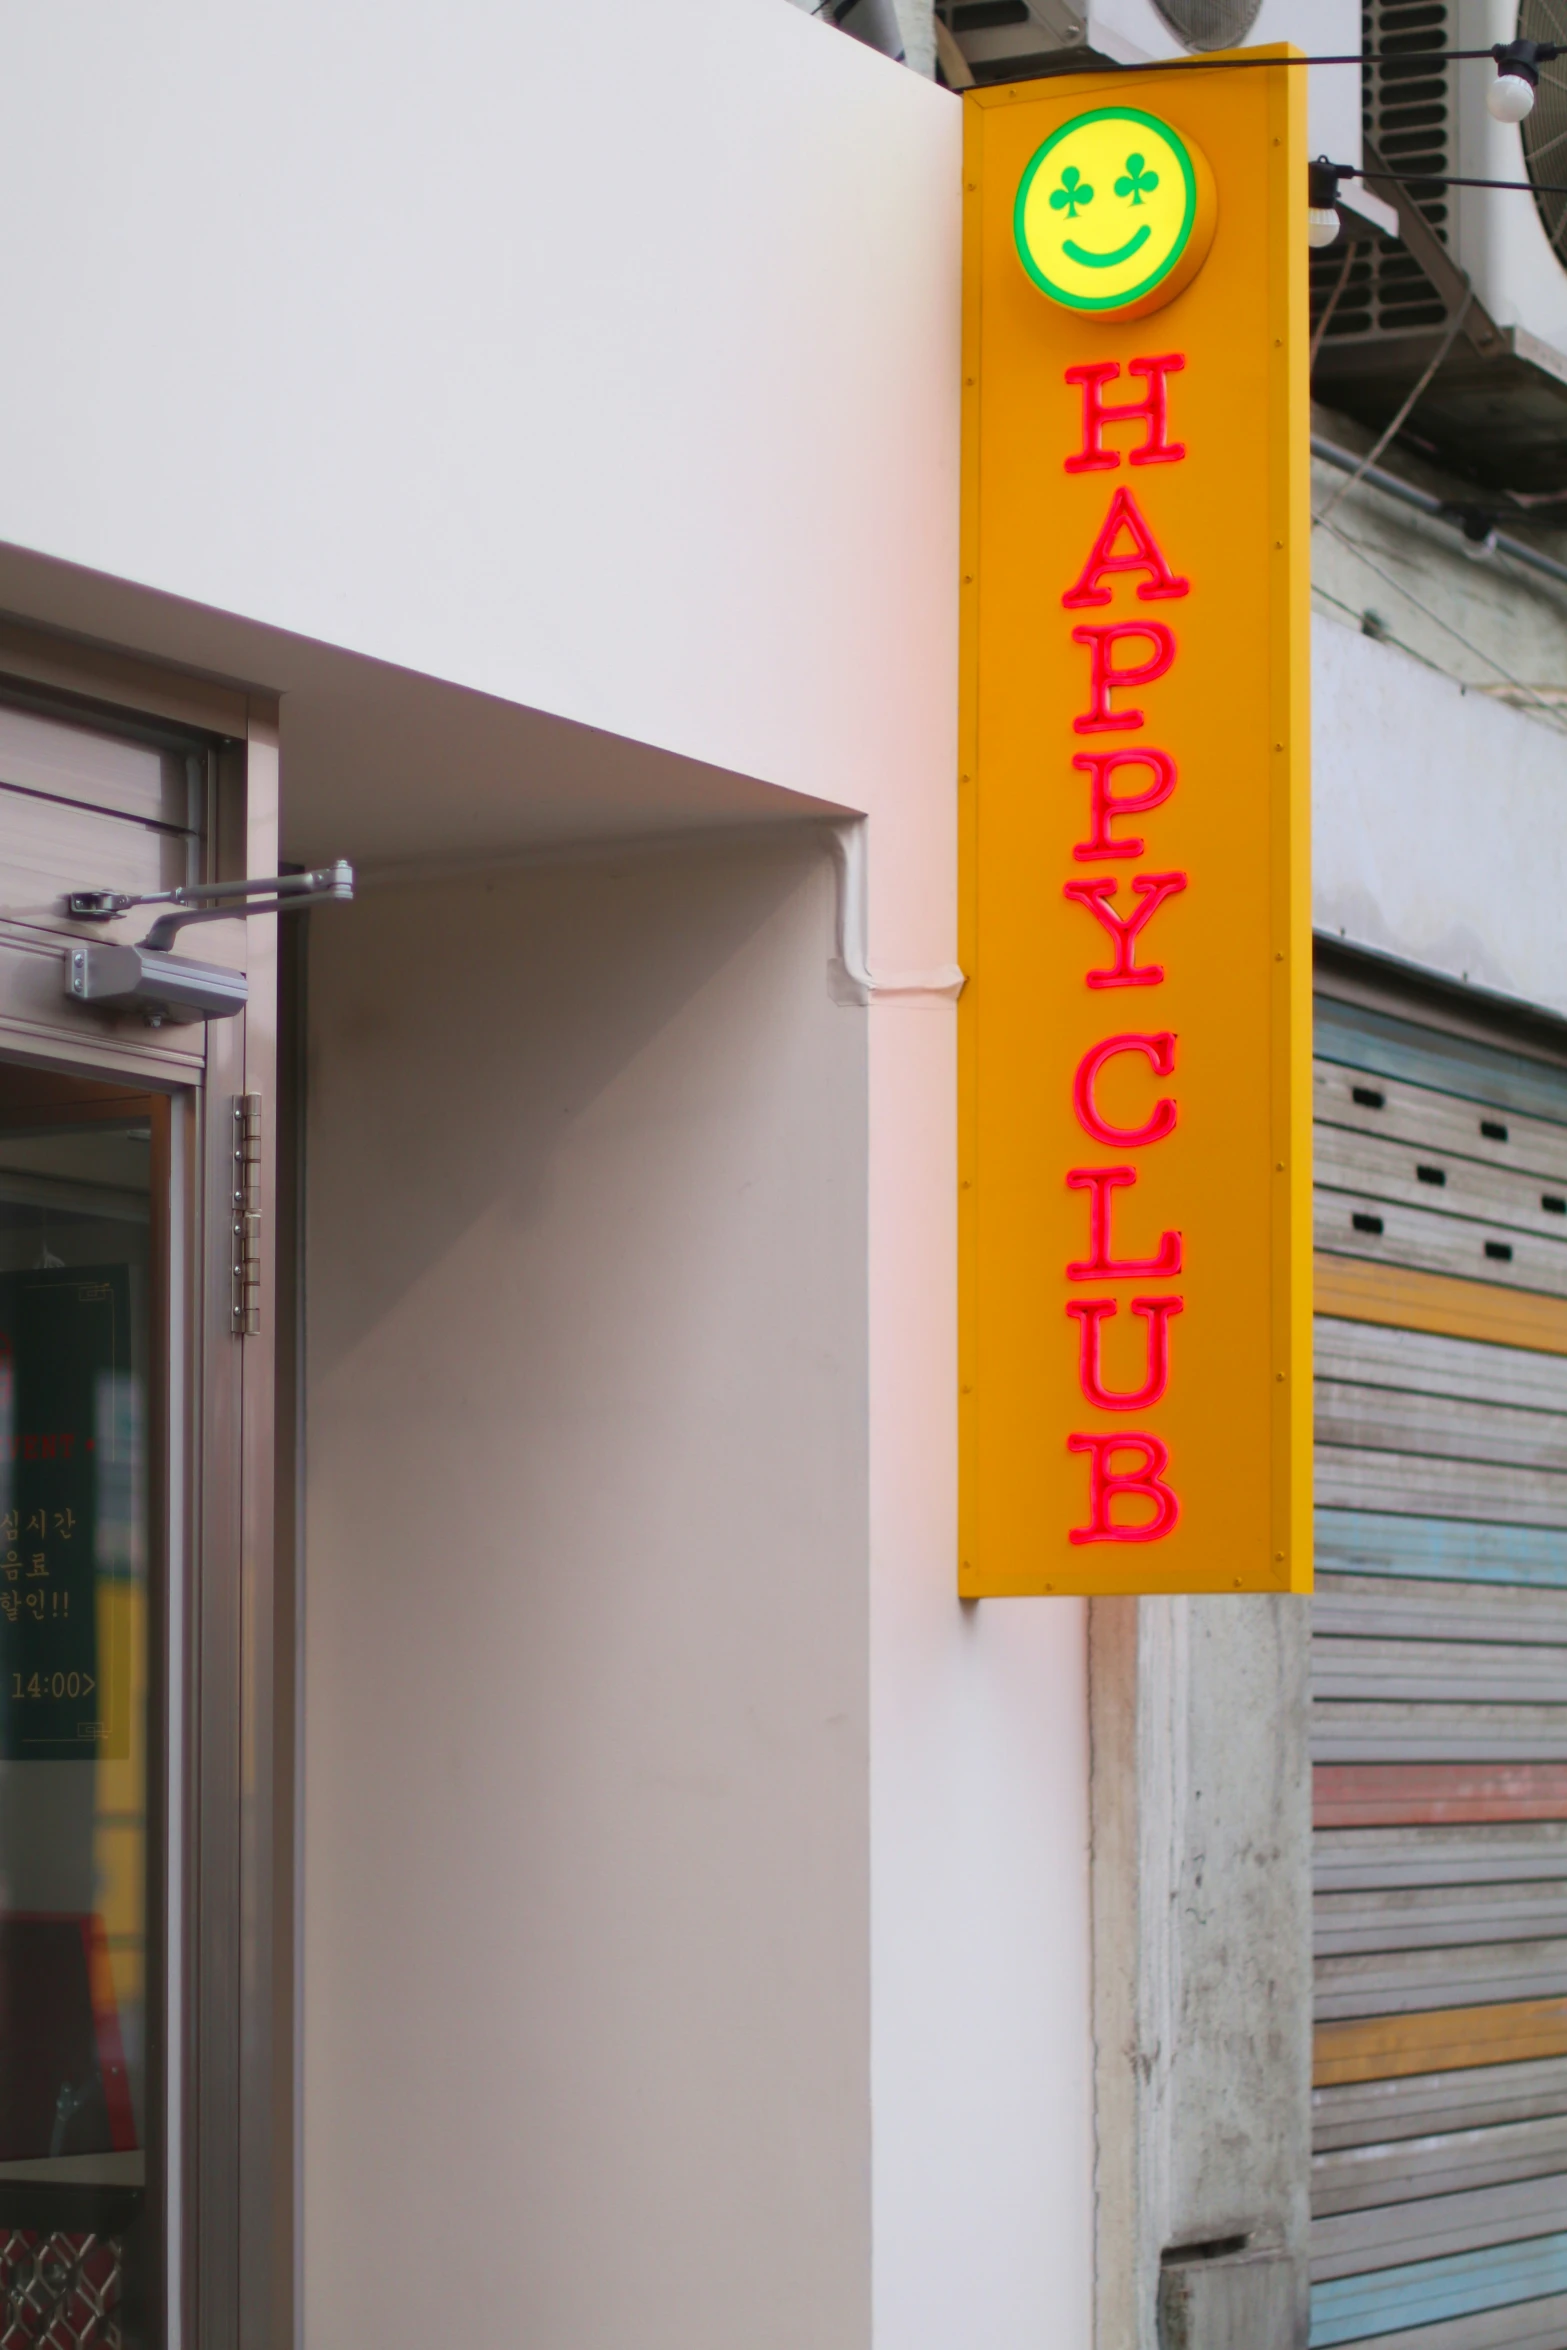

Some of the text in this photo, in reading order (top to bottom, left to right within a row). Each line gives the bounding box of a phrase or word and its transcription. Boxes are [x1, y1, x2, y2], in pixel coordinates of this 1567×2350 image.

[1063, 352, 1189, 1546] HAPPY CLUB
[0, 1433, 75, 1460] VENT
[0, 1550, 50, 1580] 음료
[11, 1672, 96, 1698] 14:00>
